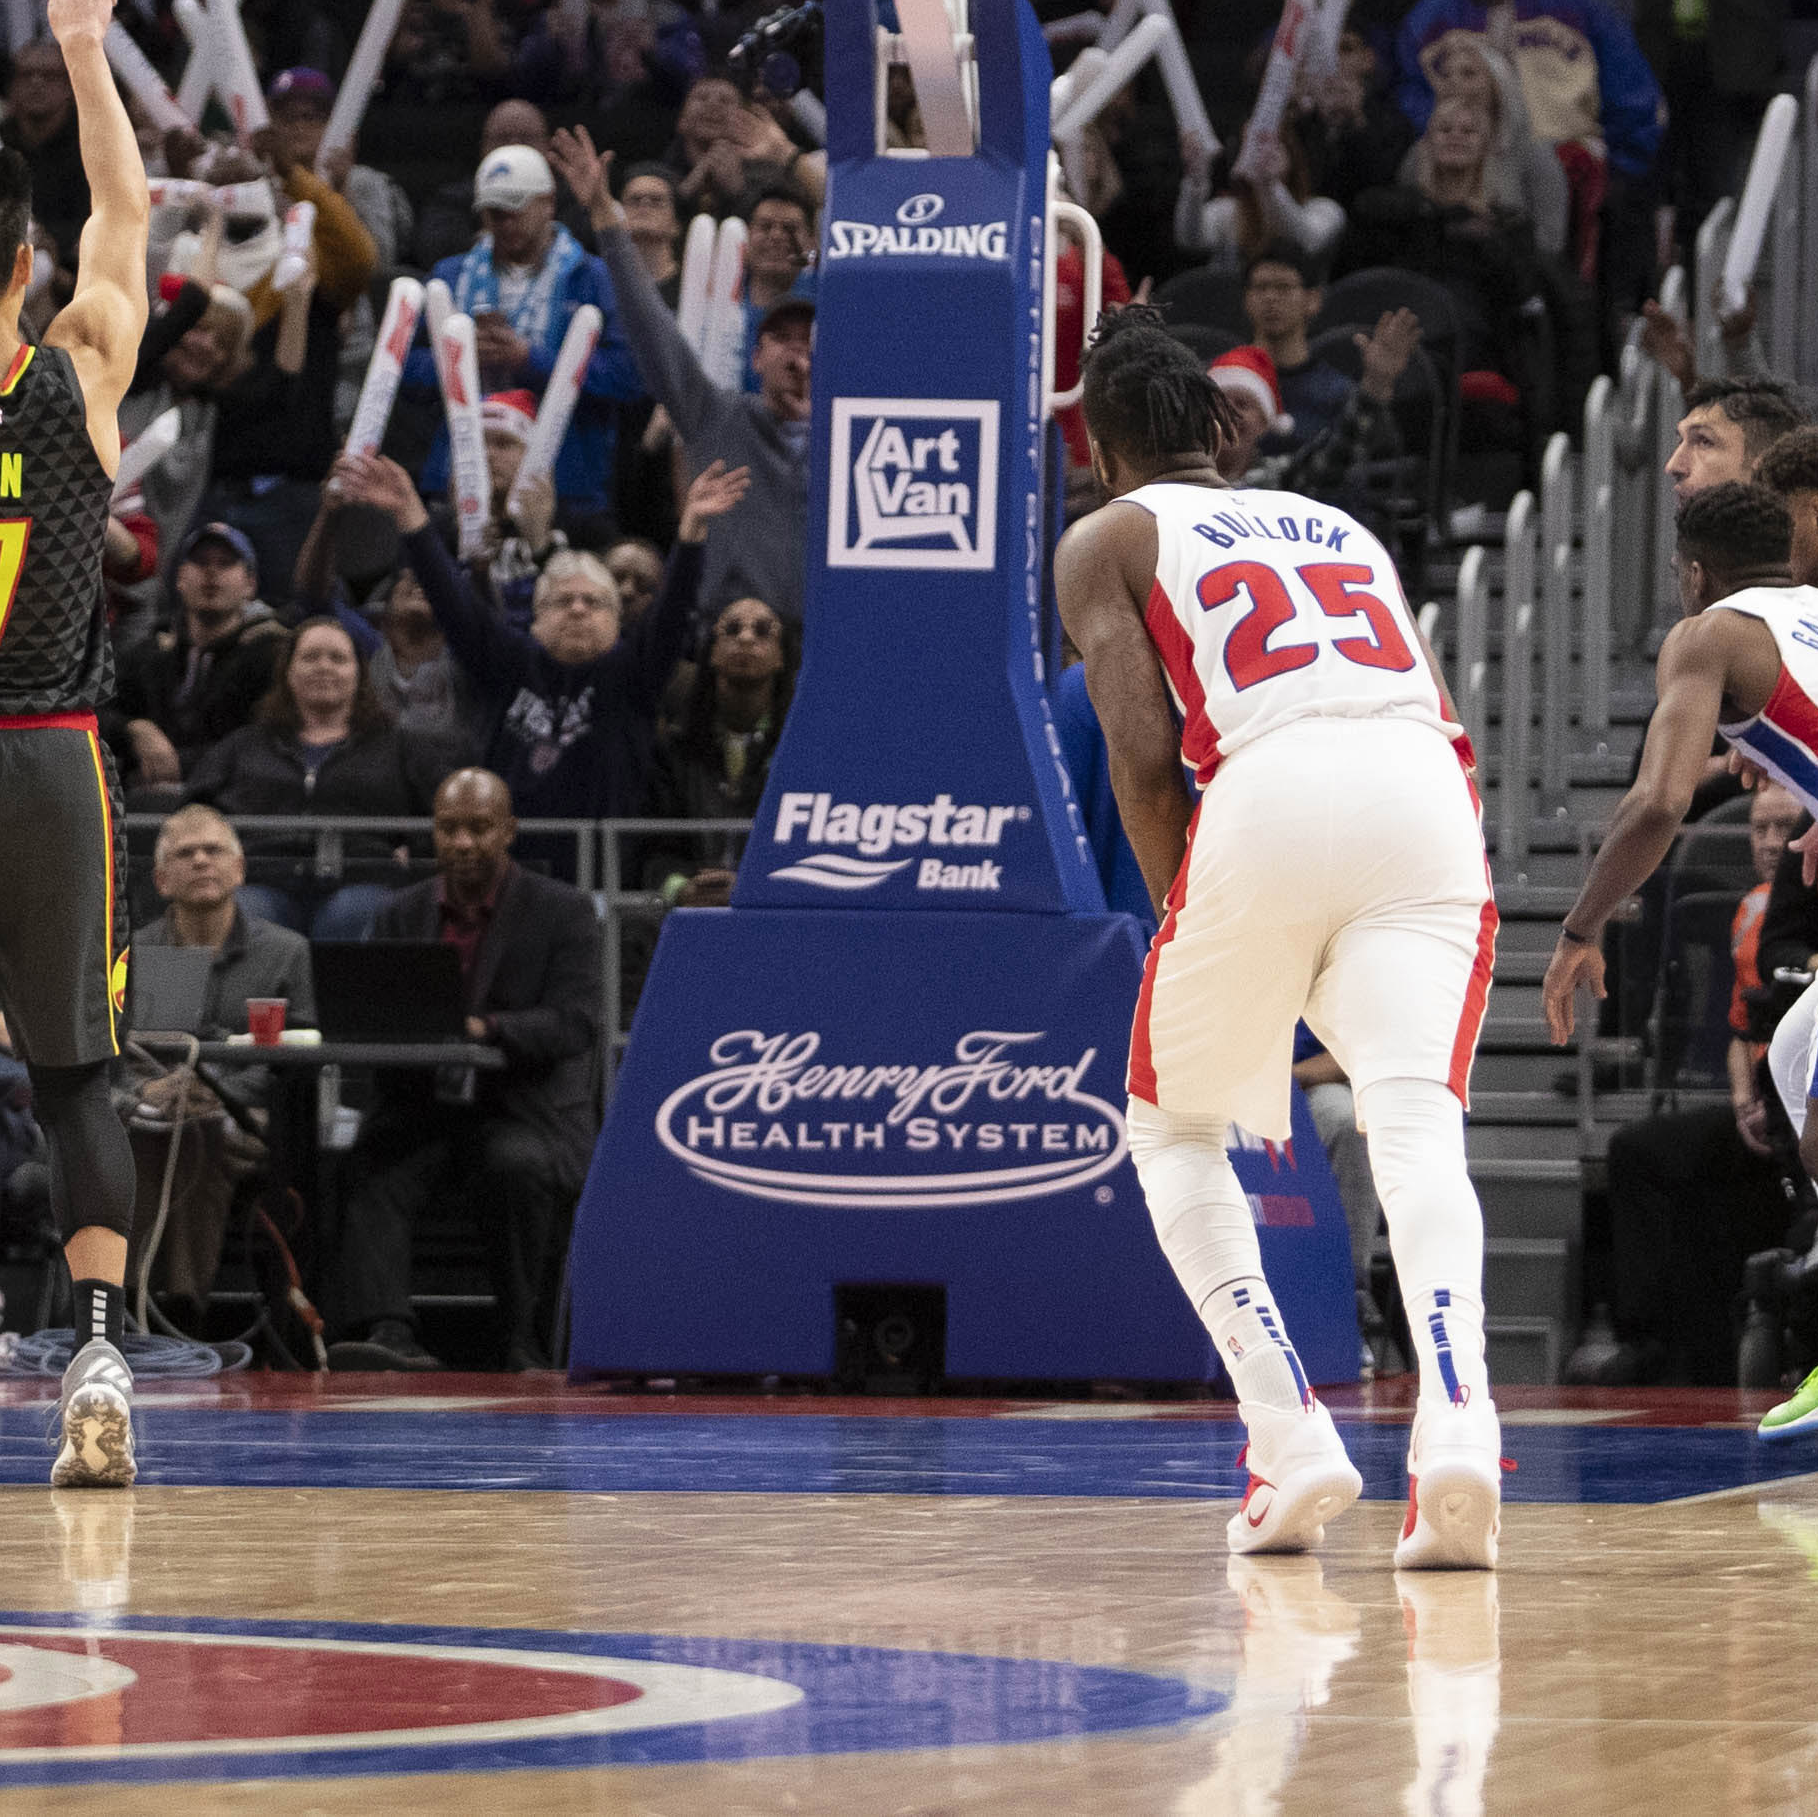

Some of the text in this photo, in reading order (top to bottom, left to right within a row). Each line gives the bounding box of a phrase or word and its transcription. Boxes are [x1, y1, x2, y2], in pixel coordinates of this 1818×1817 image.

[828, 220, 1008, 261] SPALDING
[867, 426, 959, 473] Art
[873, 469, 971, 516] Van
[1192, 512, 1353, 554] BULLOCK
[1195, 559, 1419, 695] 25
[773, 793, 1016, 858] Flagstar
[917, 857, 1003, 893] Bank
[703, 1028, 1097, 1124] Henry Ford
[686, 1114, 1112, 1151] HEALTH SYSTEM
